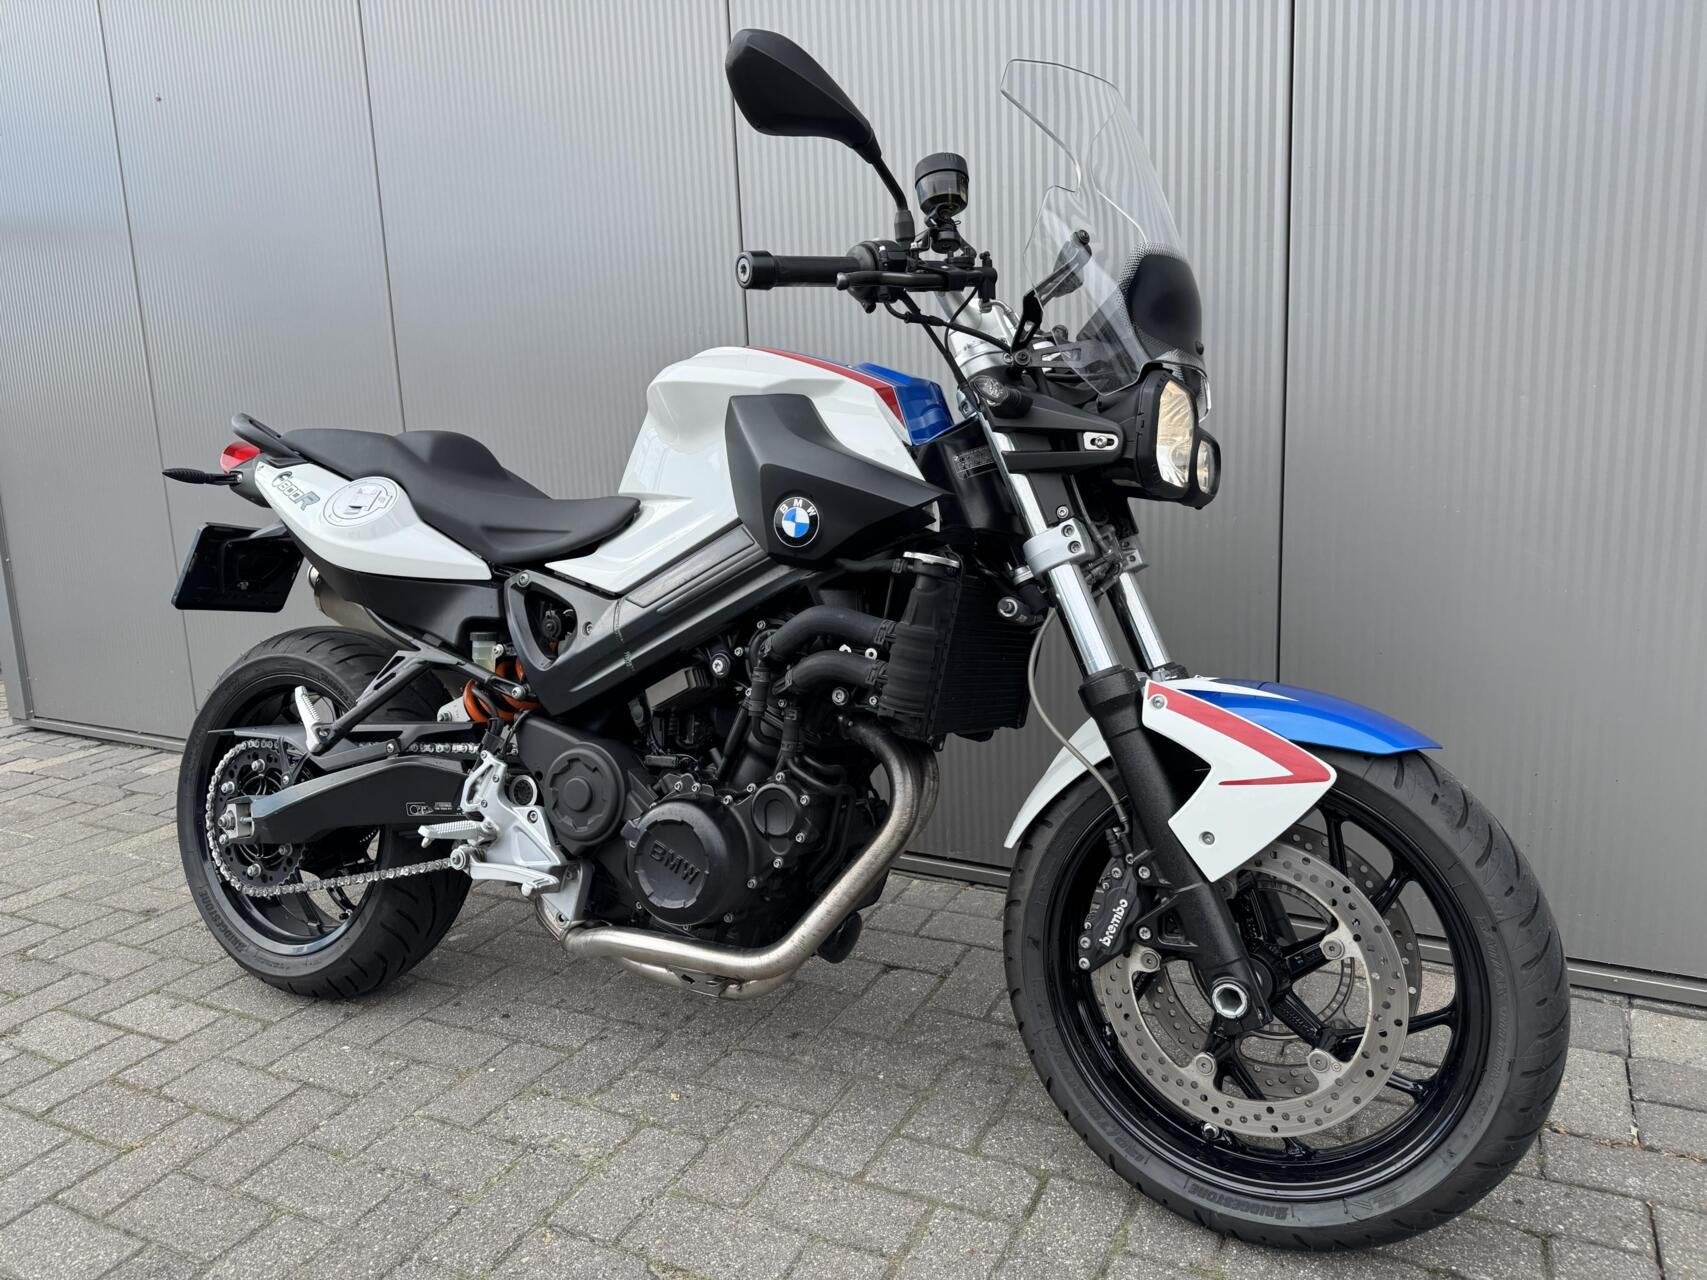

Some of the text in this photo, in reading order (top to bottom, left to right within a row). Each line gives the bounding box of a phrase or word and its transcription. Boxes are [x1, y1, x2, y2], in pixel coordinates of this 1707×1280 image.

[779, 498, 817, 517] BMW
[650, 840, 700, 885] BMW
[1099, 899, 1128, 947] brembo
